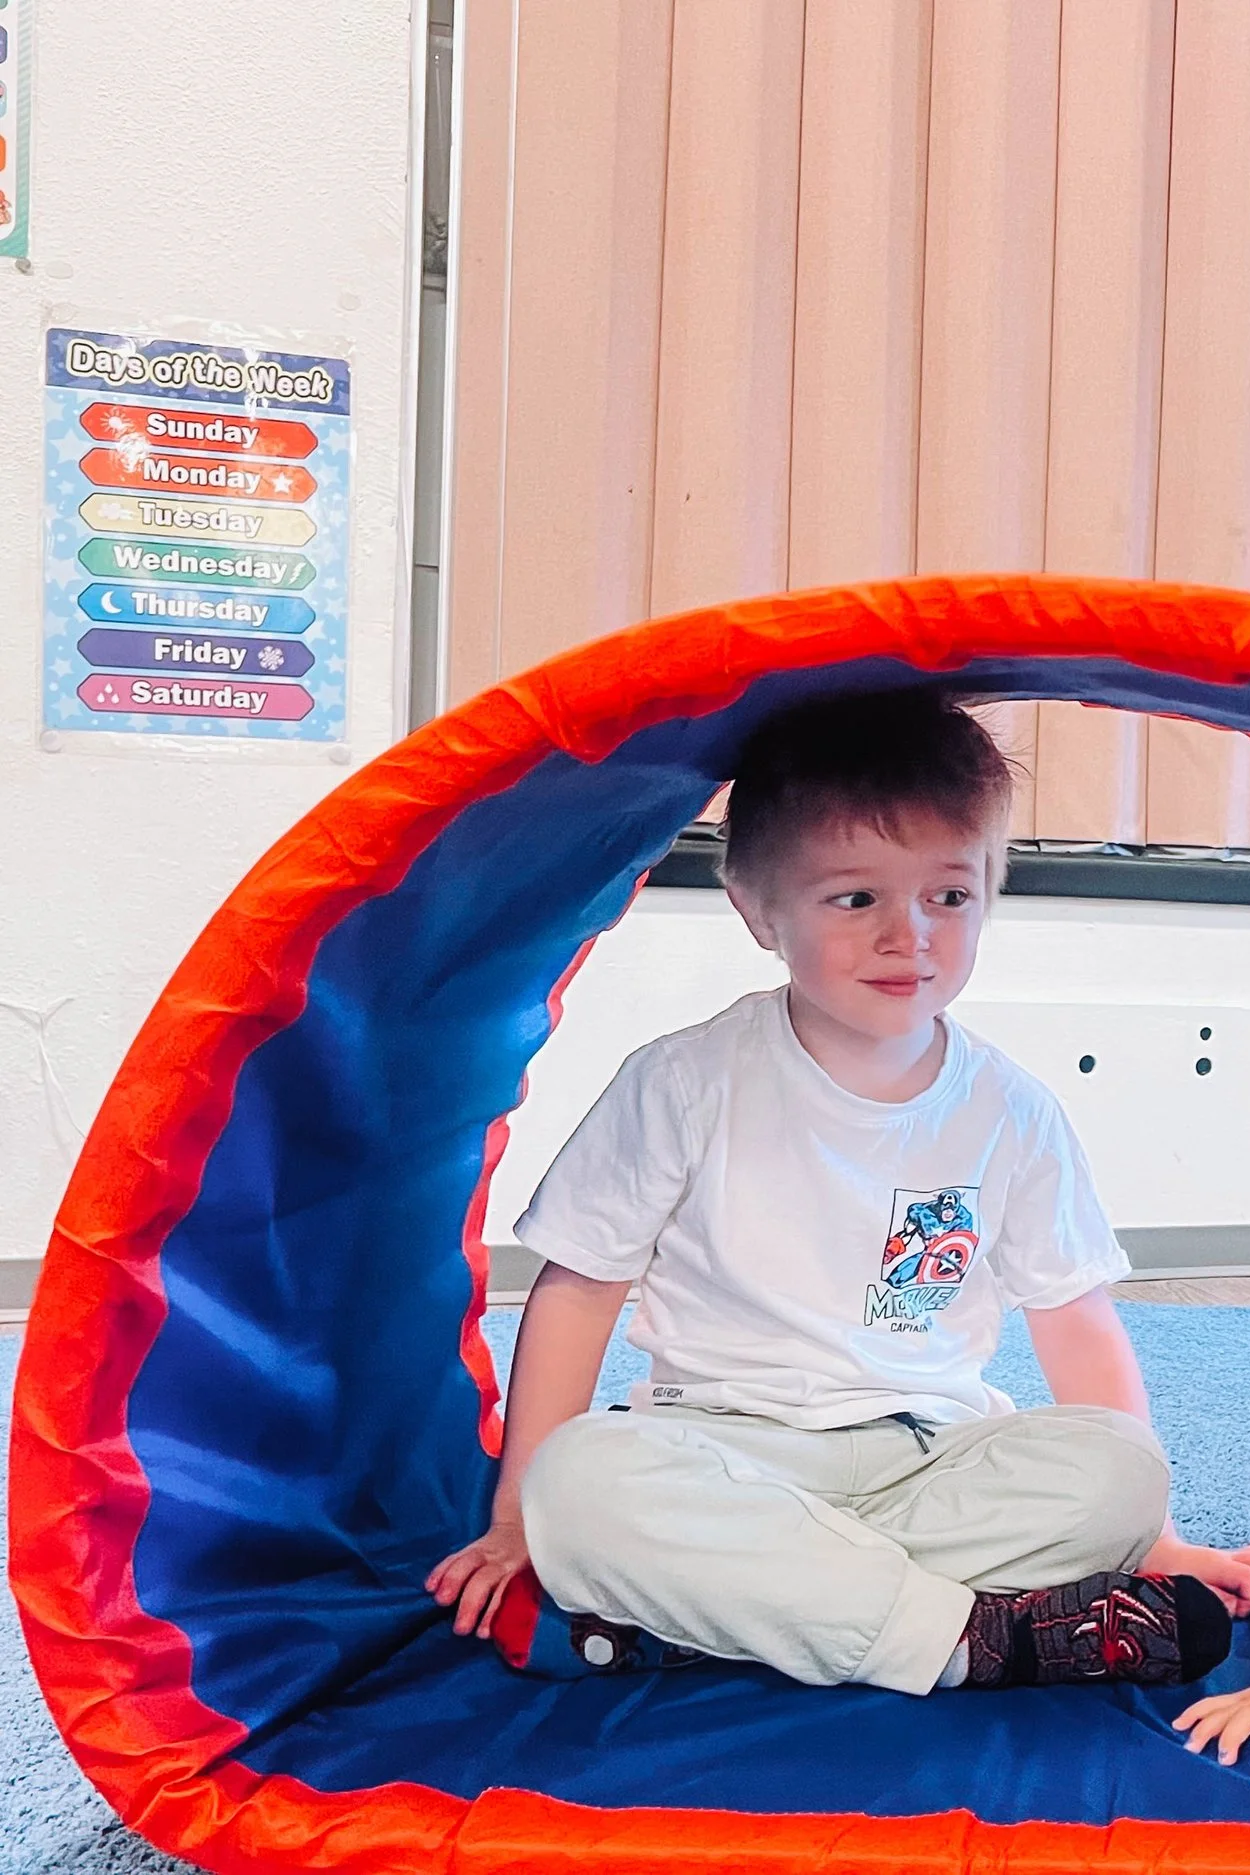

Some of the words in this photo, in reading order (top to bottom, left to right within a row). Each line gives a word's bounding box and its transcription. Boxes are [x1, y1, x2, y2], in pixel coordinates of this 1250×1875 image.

[71, 342, 145, 382] Days
[152, 356, 187, 385] of
[192, 355, 242, 389] the
[249, 366, 330, 399] Week
[147, 413, 259, 448] Sunday
[143, 459, 261, 493] Monday
[138, 501, 264, 536] Tuesday
[113, 545, 287, 584] Wednesday
[131, 592, 269, 627] Thursday
[154, 638, 247, 670] Friday
[131, 680, 267, 714] Saturday
